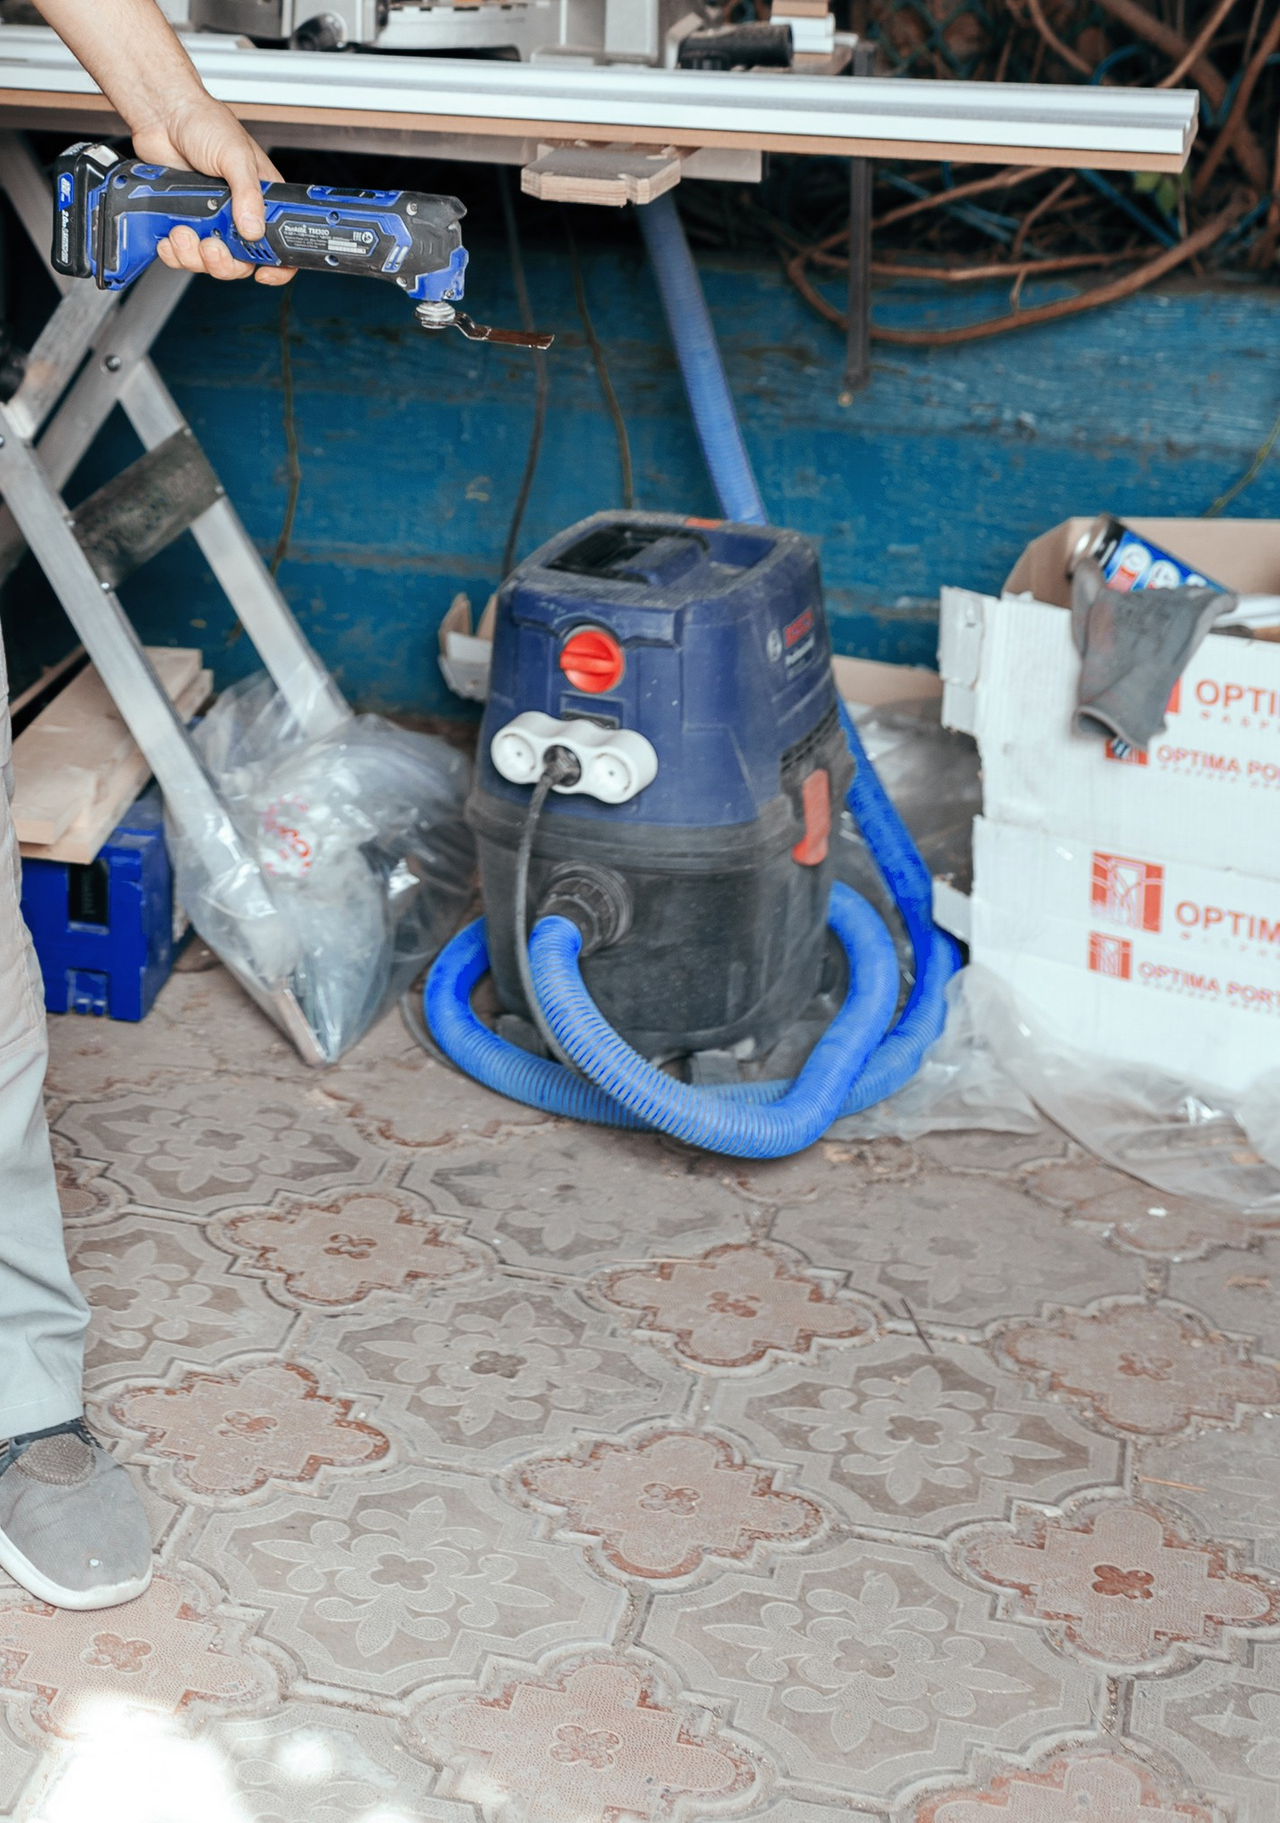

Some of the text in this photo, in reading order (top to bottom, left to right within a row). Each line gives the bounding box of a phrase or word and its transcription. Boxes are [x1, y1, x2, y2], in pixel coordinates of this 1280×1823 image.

[1195, 679, 1280, 716] OPTI
[1157, 745, 1241, 774] OPTIMA
[1247, 760, 1280, 781] PO
[1139, 962, 1219, 992] OPTIMA
